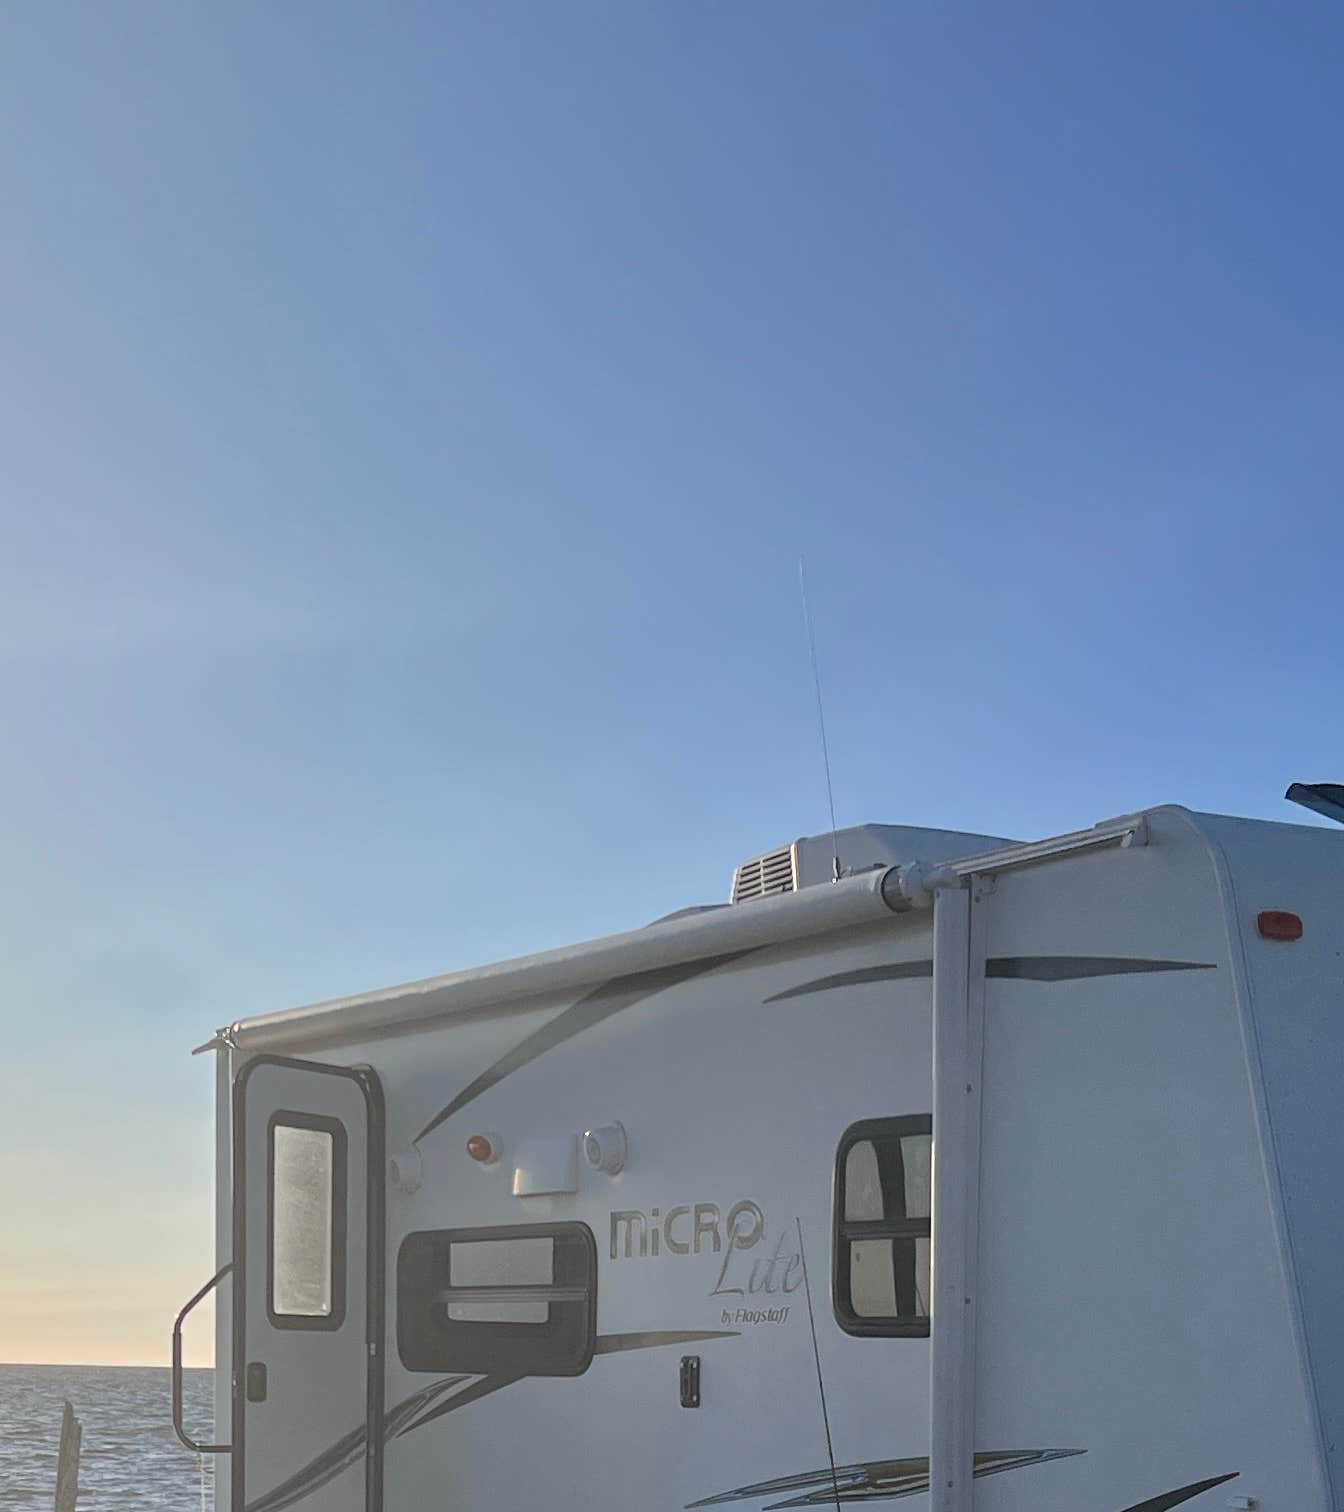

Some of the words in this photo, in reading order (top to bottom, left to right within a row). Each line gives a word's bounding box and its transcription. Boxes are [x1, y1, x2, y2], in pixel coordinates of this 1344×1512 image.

[709, 1223, 805, 1297] Lite
[721, 1308, 735, 1327] by
[735, 1306, 791, 1325] Flagstaff
